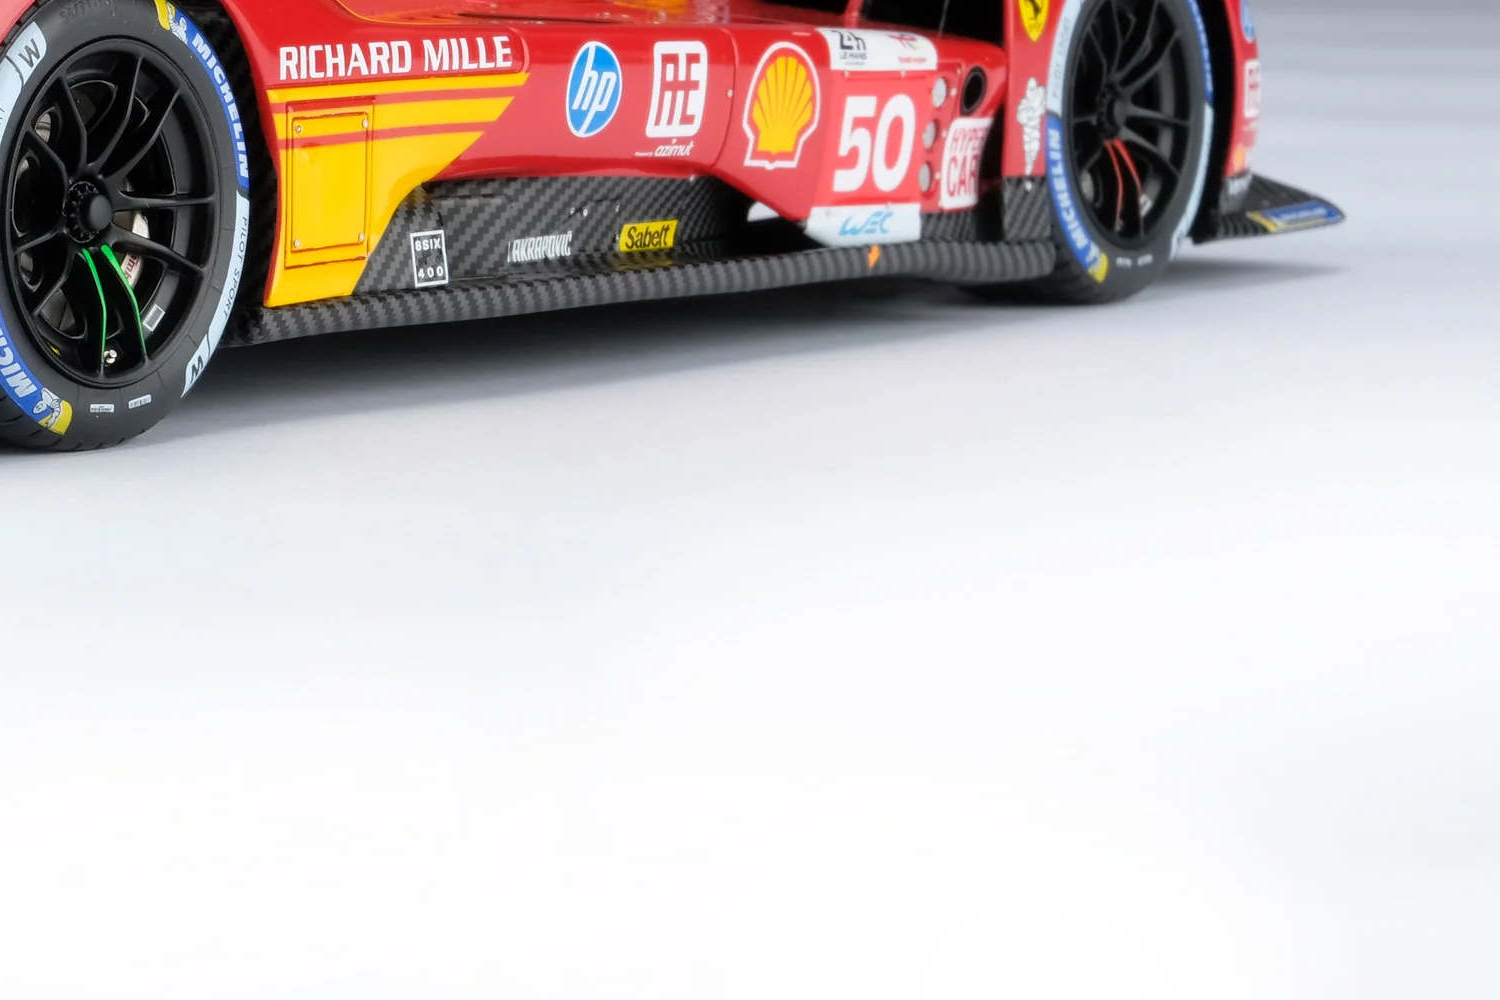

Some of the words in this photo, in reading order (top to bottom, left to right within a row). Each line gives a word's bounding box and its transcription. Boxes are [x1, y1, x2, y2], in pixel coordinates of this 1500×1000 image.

[18, 36, 41, 70] W
[279, 40, 412, 80] RICHARD
[422, 35, 513, 72] MILLE
[191, 32, 250, 179] MICHELIN
[570, 44, 618, 135] hp
[654, 138, 694, 157] azimut
[832, 93, 916, 193] 50
[237, 215, 248, 264] PILOT
[625, 224, 670, 249] Sabelt
[838, 211, 895, 237] WEC
[414, 237, 442, 252] 8SIX
[417, 264, 444, 279] 400
[224, 268, 240, 320] SPORT
